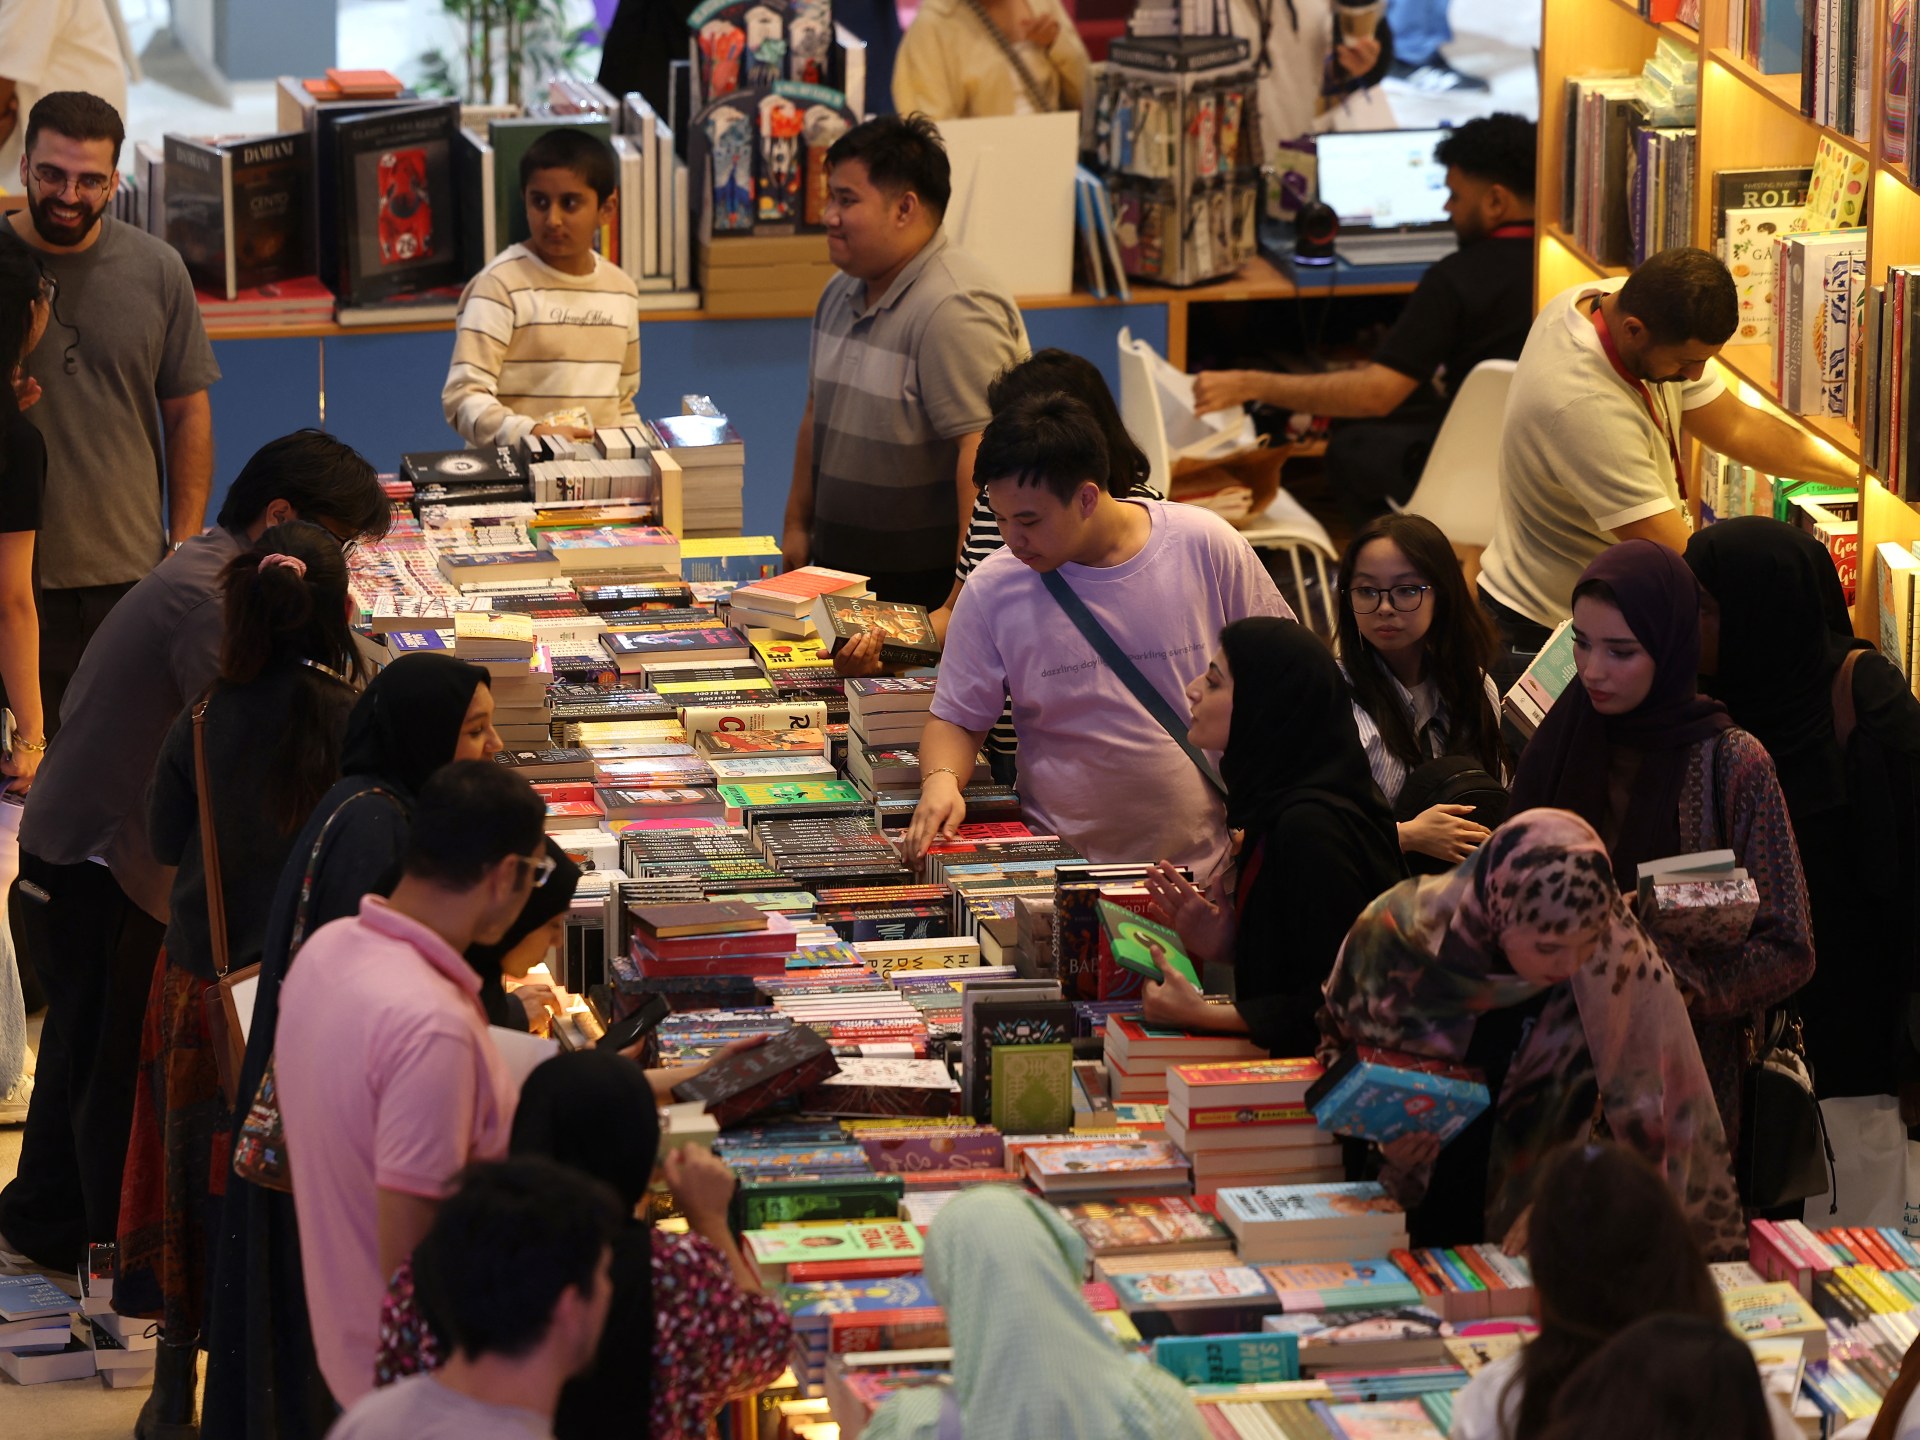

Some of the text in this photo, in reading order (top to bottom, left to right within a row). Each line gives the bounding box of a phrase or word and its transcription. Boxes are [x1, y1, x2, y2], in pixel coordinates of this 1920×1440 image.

[244, 141, 294, 164] DAMIANI
[1041, 661, 1079, 678] dazzling
[1081, 657, 1107, 671] dayli
[1128, 650, 1167, 661] parkling
[1289, 1109, 1311, 1117] YUZU
